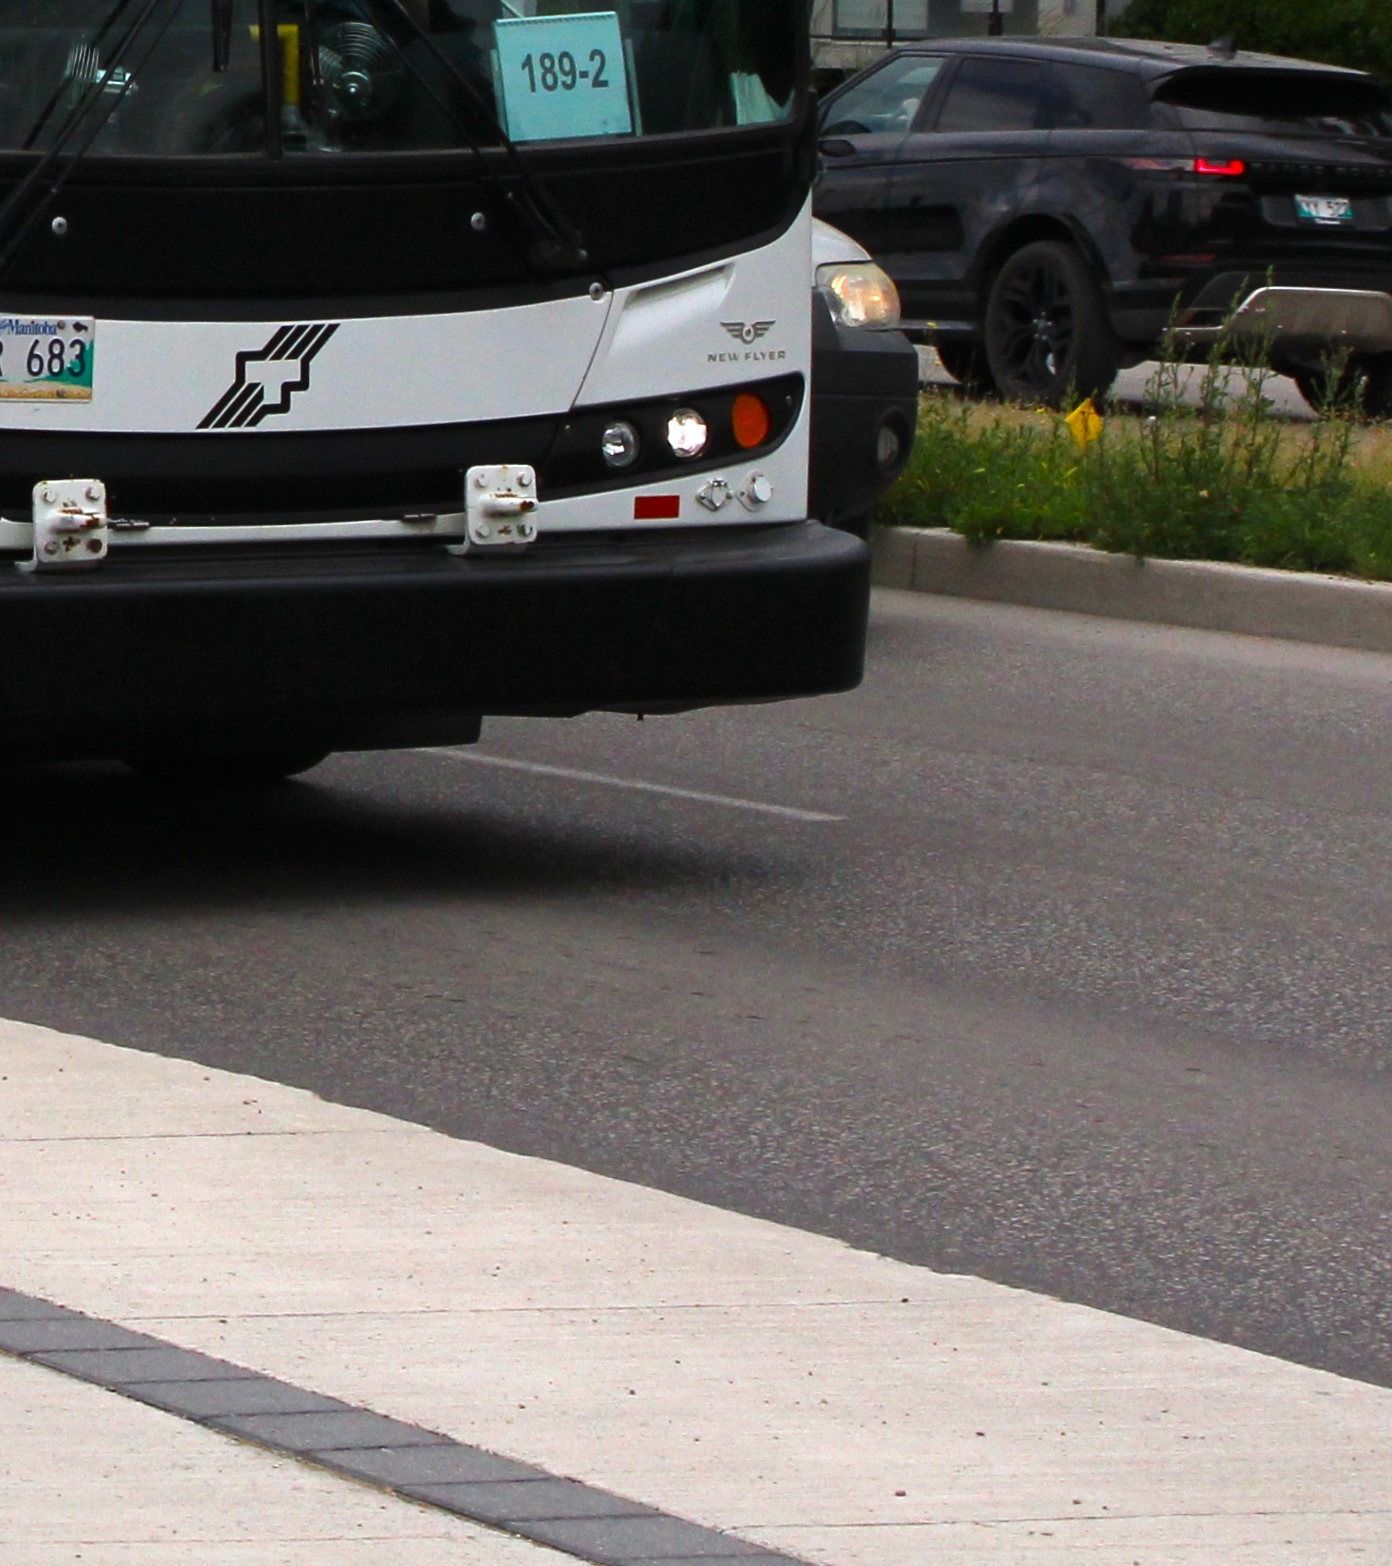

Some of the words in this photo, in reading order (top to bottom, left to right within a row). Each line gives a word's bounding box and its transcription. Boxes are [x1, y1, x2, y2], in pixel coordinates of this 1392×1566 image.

[521, 49, 609, 93] 189-2
[8, 318, 58, 335] Manitoba
[26, 337, 87, 377] 683
[707, 352, 739, 363] NEW
[744, 350, 787, 362] FLYER
